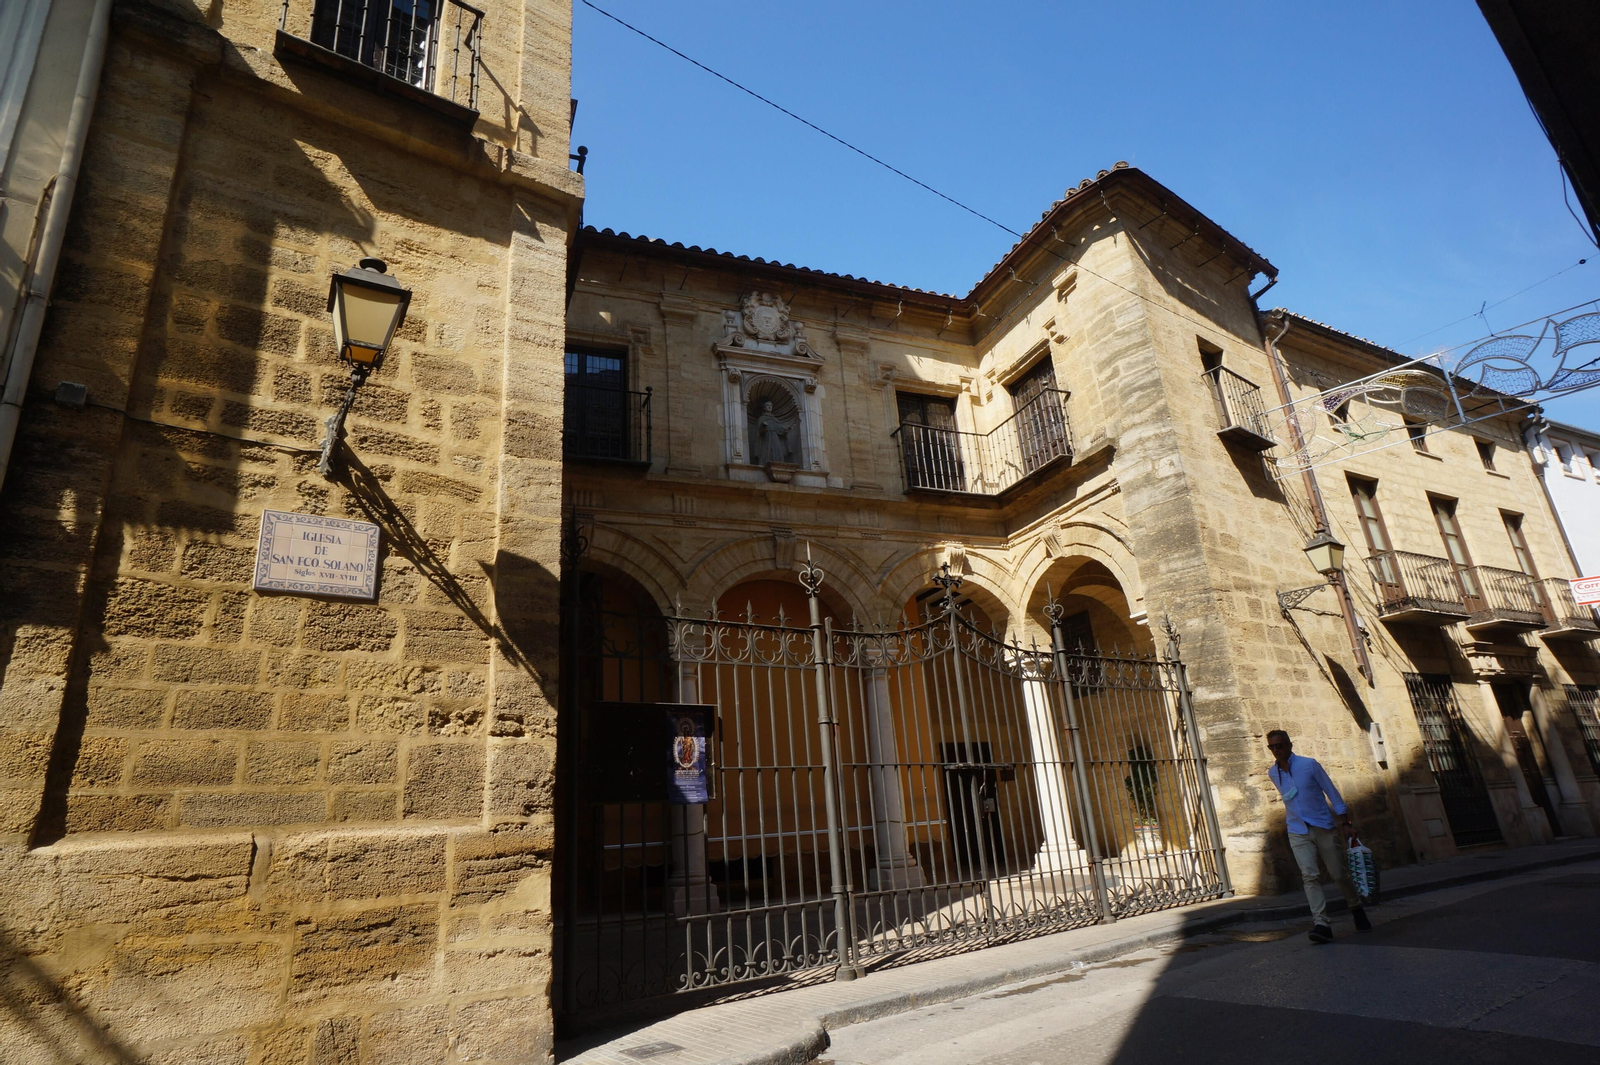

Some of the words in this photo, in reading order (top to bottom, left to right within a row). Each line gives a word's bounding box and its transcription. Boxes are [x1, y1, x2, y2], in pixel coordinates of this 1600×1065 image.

[302, 531, 342, 545] IGLESIA
[314, 545, 328, 556] DE
[271, 553, 294, 565] SAN
[323, 559, 364, 573] SOLANO
[294, 568, 316, 577] Siglos
